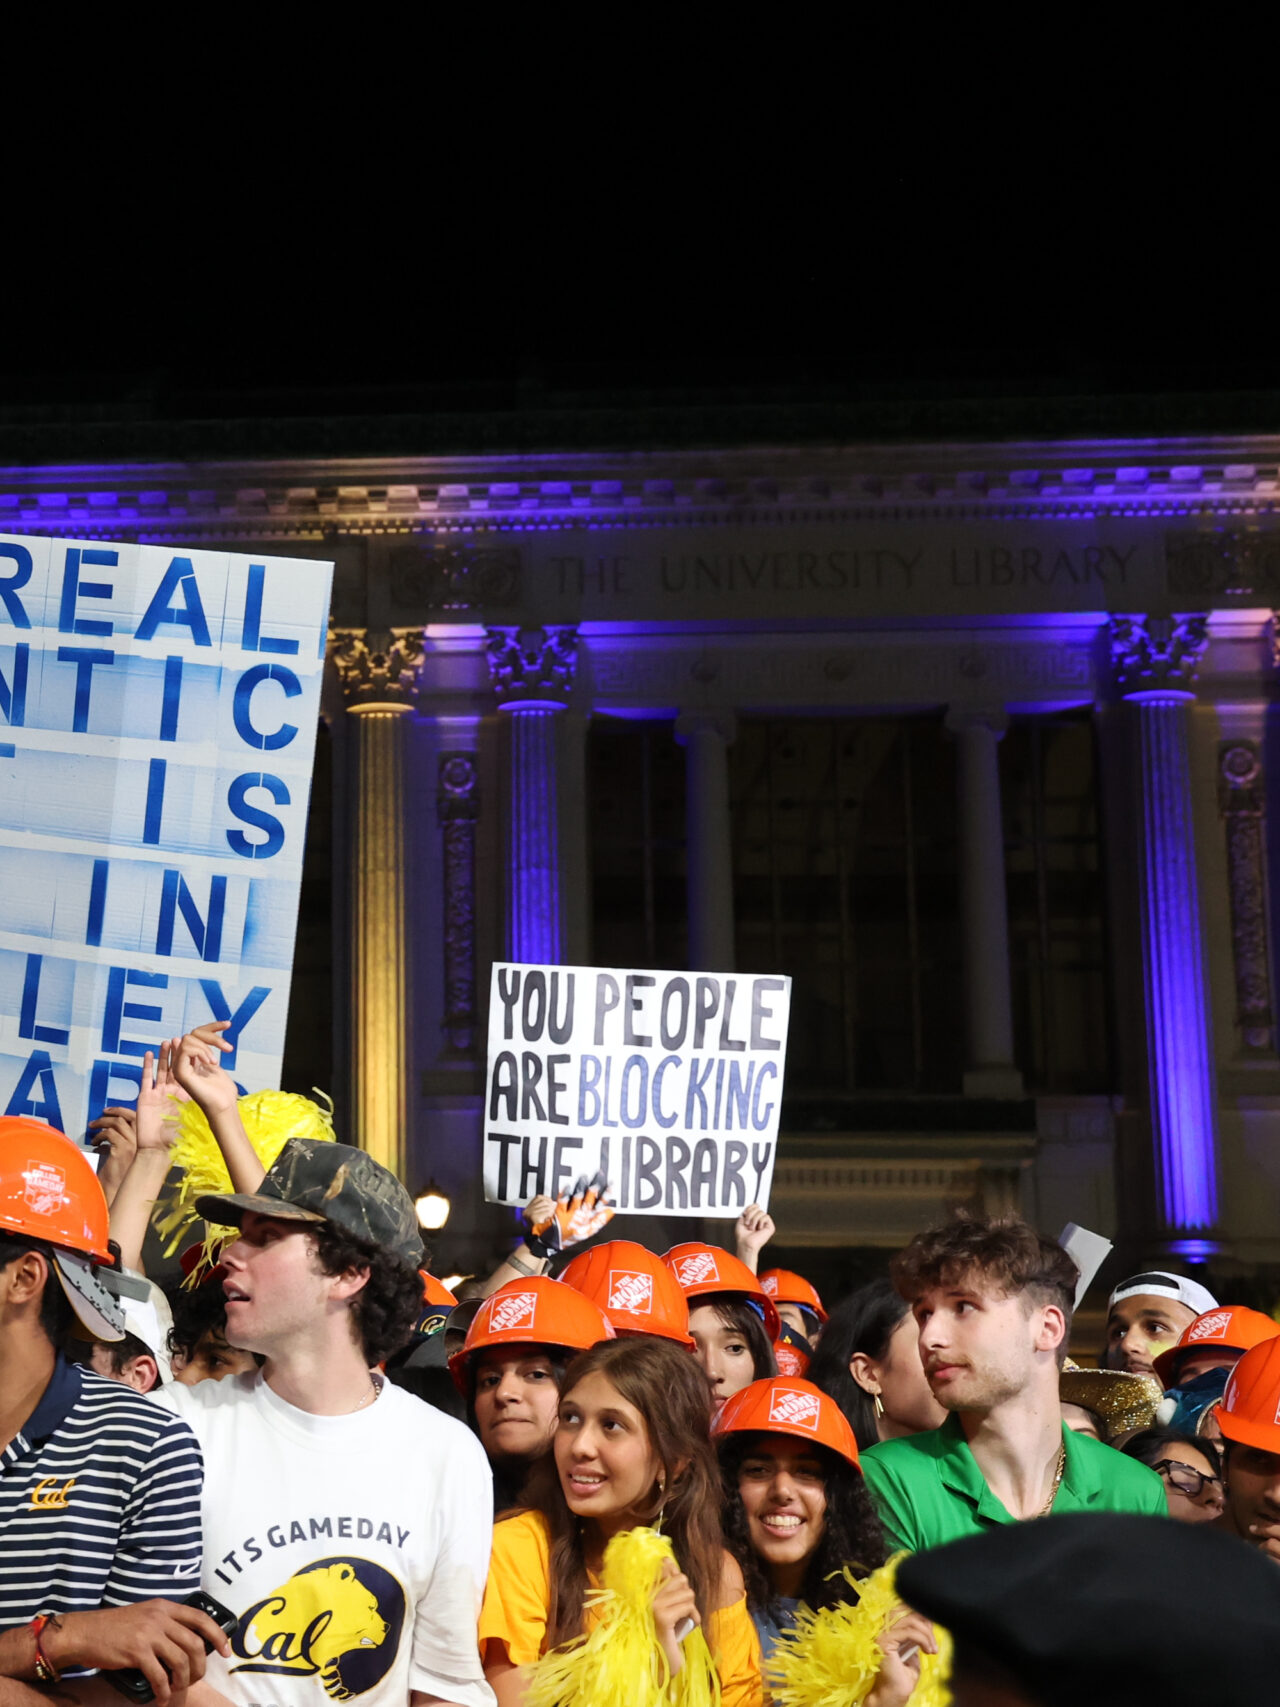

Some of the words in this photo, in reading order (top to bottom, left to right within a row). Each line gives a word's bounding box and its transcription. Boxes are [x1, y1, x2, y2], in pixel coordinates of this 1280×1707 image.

[549, 556, 631, 596] THE
[659, 549, 925, 594] UNIVERSITY
[949, 544, 1141, 588] LIBRARY
[143, 758, 291, 859] IS
[86, 860, 227, 962] IN
[497, 968, 575, 1045] YOU
[593, 973, 786, 1051] PEOPLE
[489, 1051, 571, 1125] ARE
[577, 1054, 778, 1131] BLOCKING
[488, 1132, 583, 1201] THE
[599, 1136, 772, 1209] LIBRARY
[490, 1294, 536, 1330] HOME
[505, 1303, 534, 1328] DEPOT
[609, 1274, 651, 1309] HOME
[625, 1286, 651, 1309] DEPOT
[770, 1394, 819, 1421] HOME
[789, 1406, 818, 1423] DEPOT
[28, 1476, 76, 1511] Cal
[214, 1536, 263, 1586] ITS
[267, 1516, 410, 1549] GAMEDAY
[228, 1596, 333, 1677] Cal
